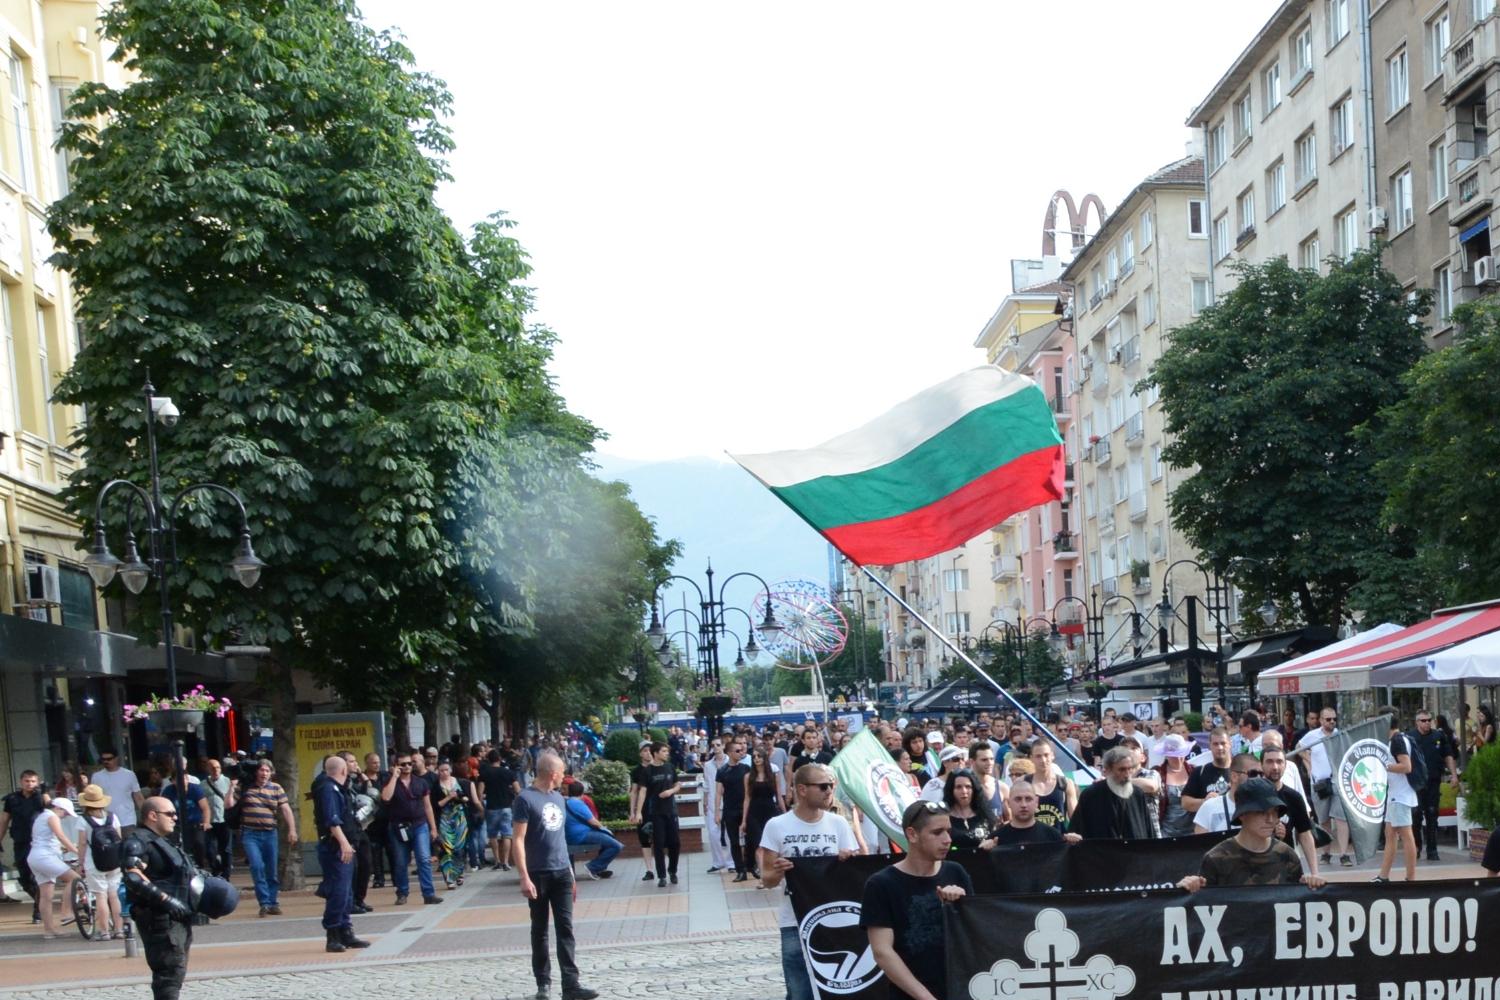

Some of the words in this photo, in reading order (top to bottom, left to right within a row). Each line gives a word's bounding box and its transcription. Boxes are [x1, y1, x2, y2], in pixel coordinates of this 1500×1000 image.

[810, 834, 821, 843] OF
[823, 834, 837, 844] THE
[1160, 902, 1245, 968] АХ,
[1274, 896, 1478, 960] ЕВРОПО!
